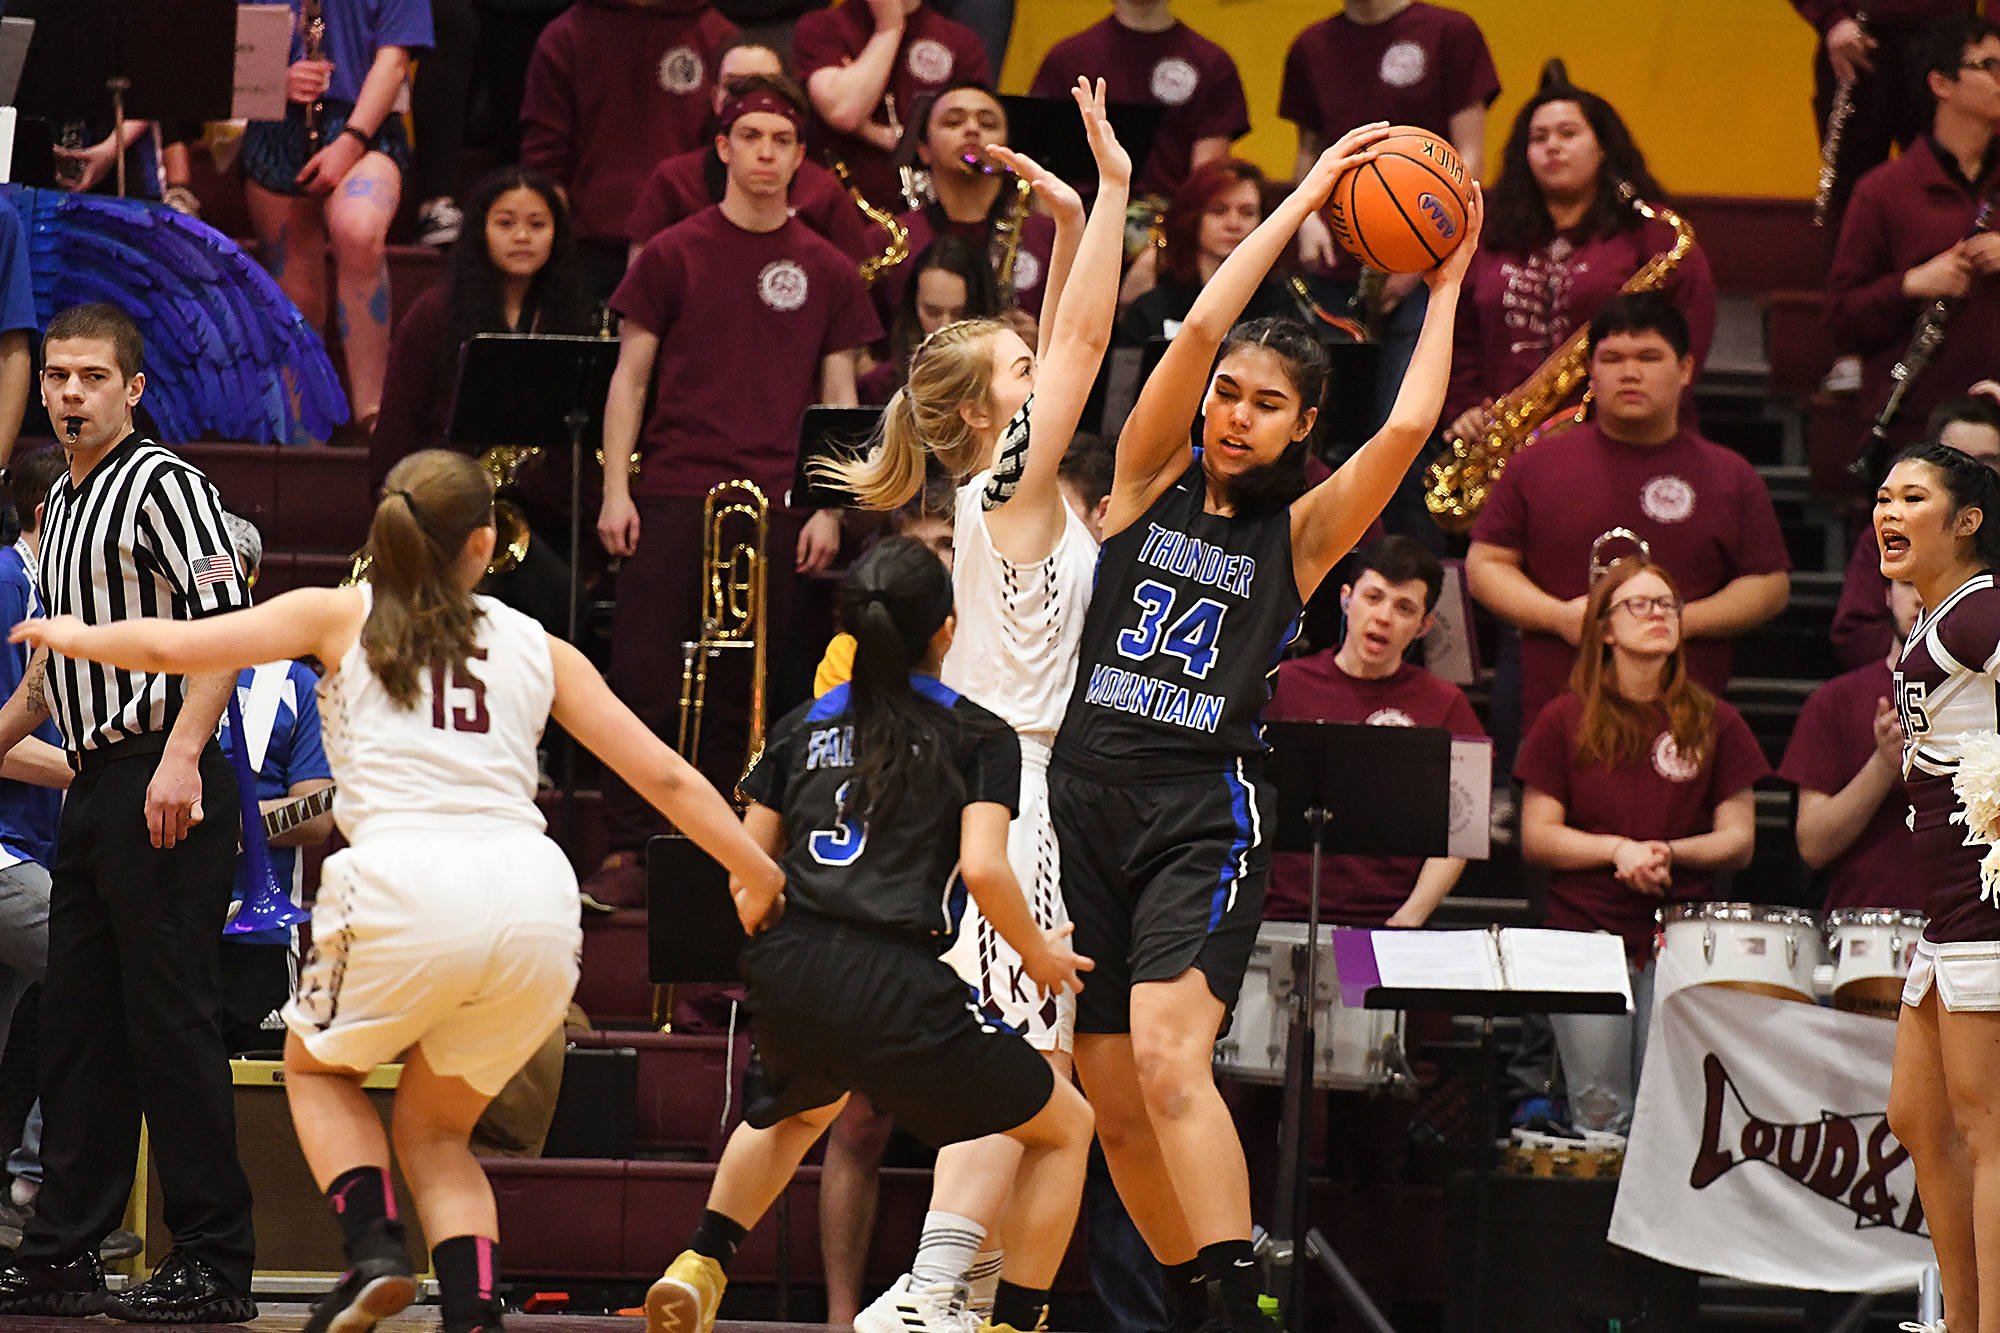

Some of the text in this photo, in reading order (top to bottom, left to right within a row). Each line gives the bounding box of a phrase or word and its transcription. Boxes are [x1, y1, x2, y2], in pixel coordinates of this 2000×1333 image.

[1137, 522, 1255, 599] THUNDER
[1116, 578, 1229, 680] 34
[430, 646, 490, 733] 15
[1085, 663, 1225, 734] MOUNTAIN
[808, 780, 872, 866] 3
[1008, 965, 1029, 1003] K
[1690, 1052, 1925, 1233] LOUD&
